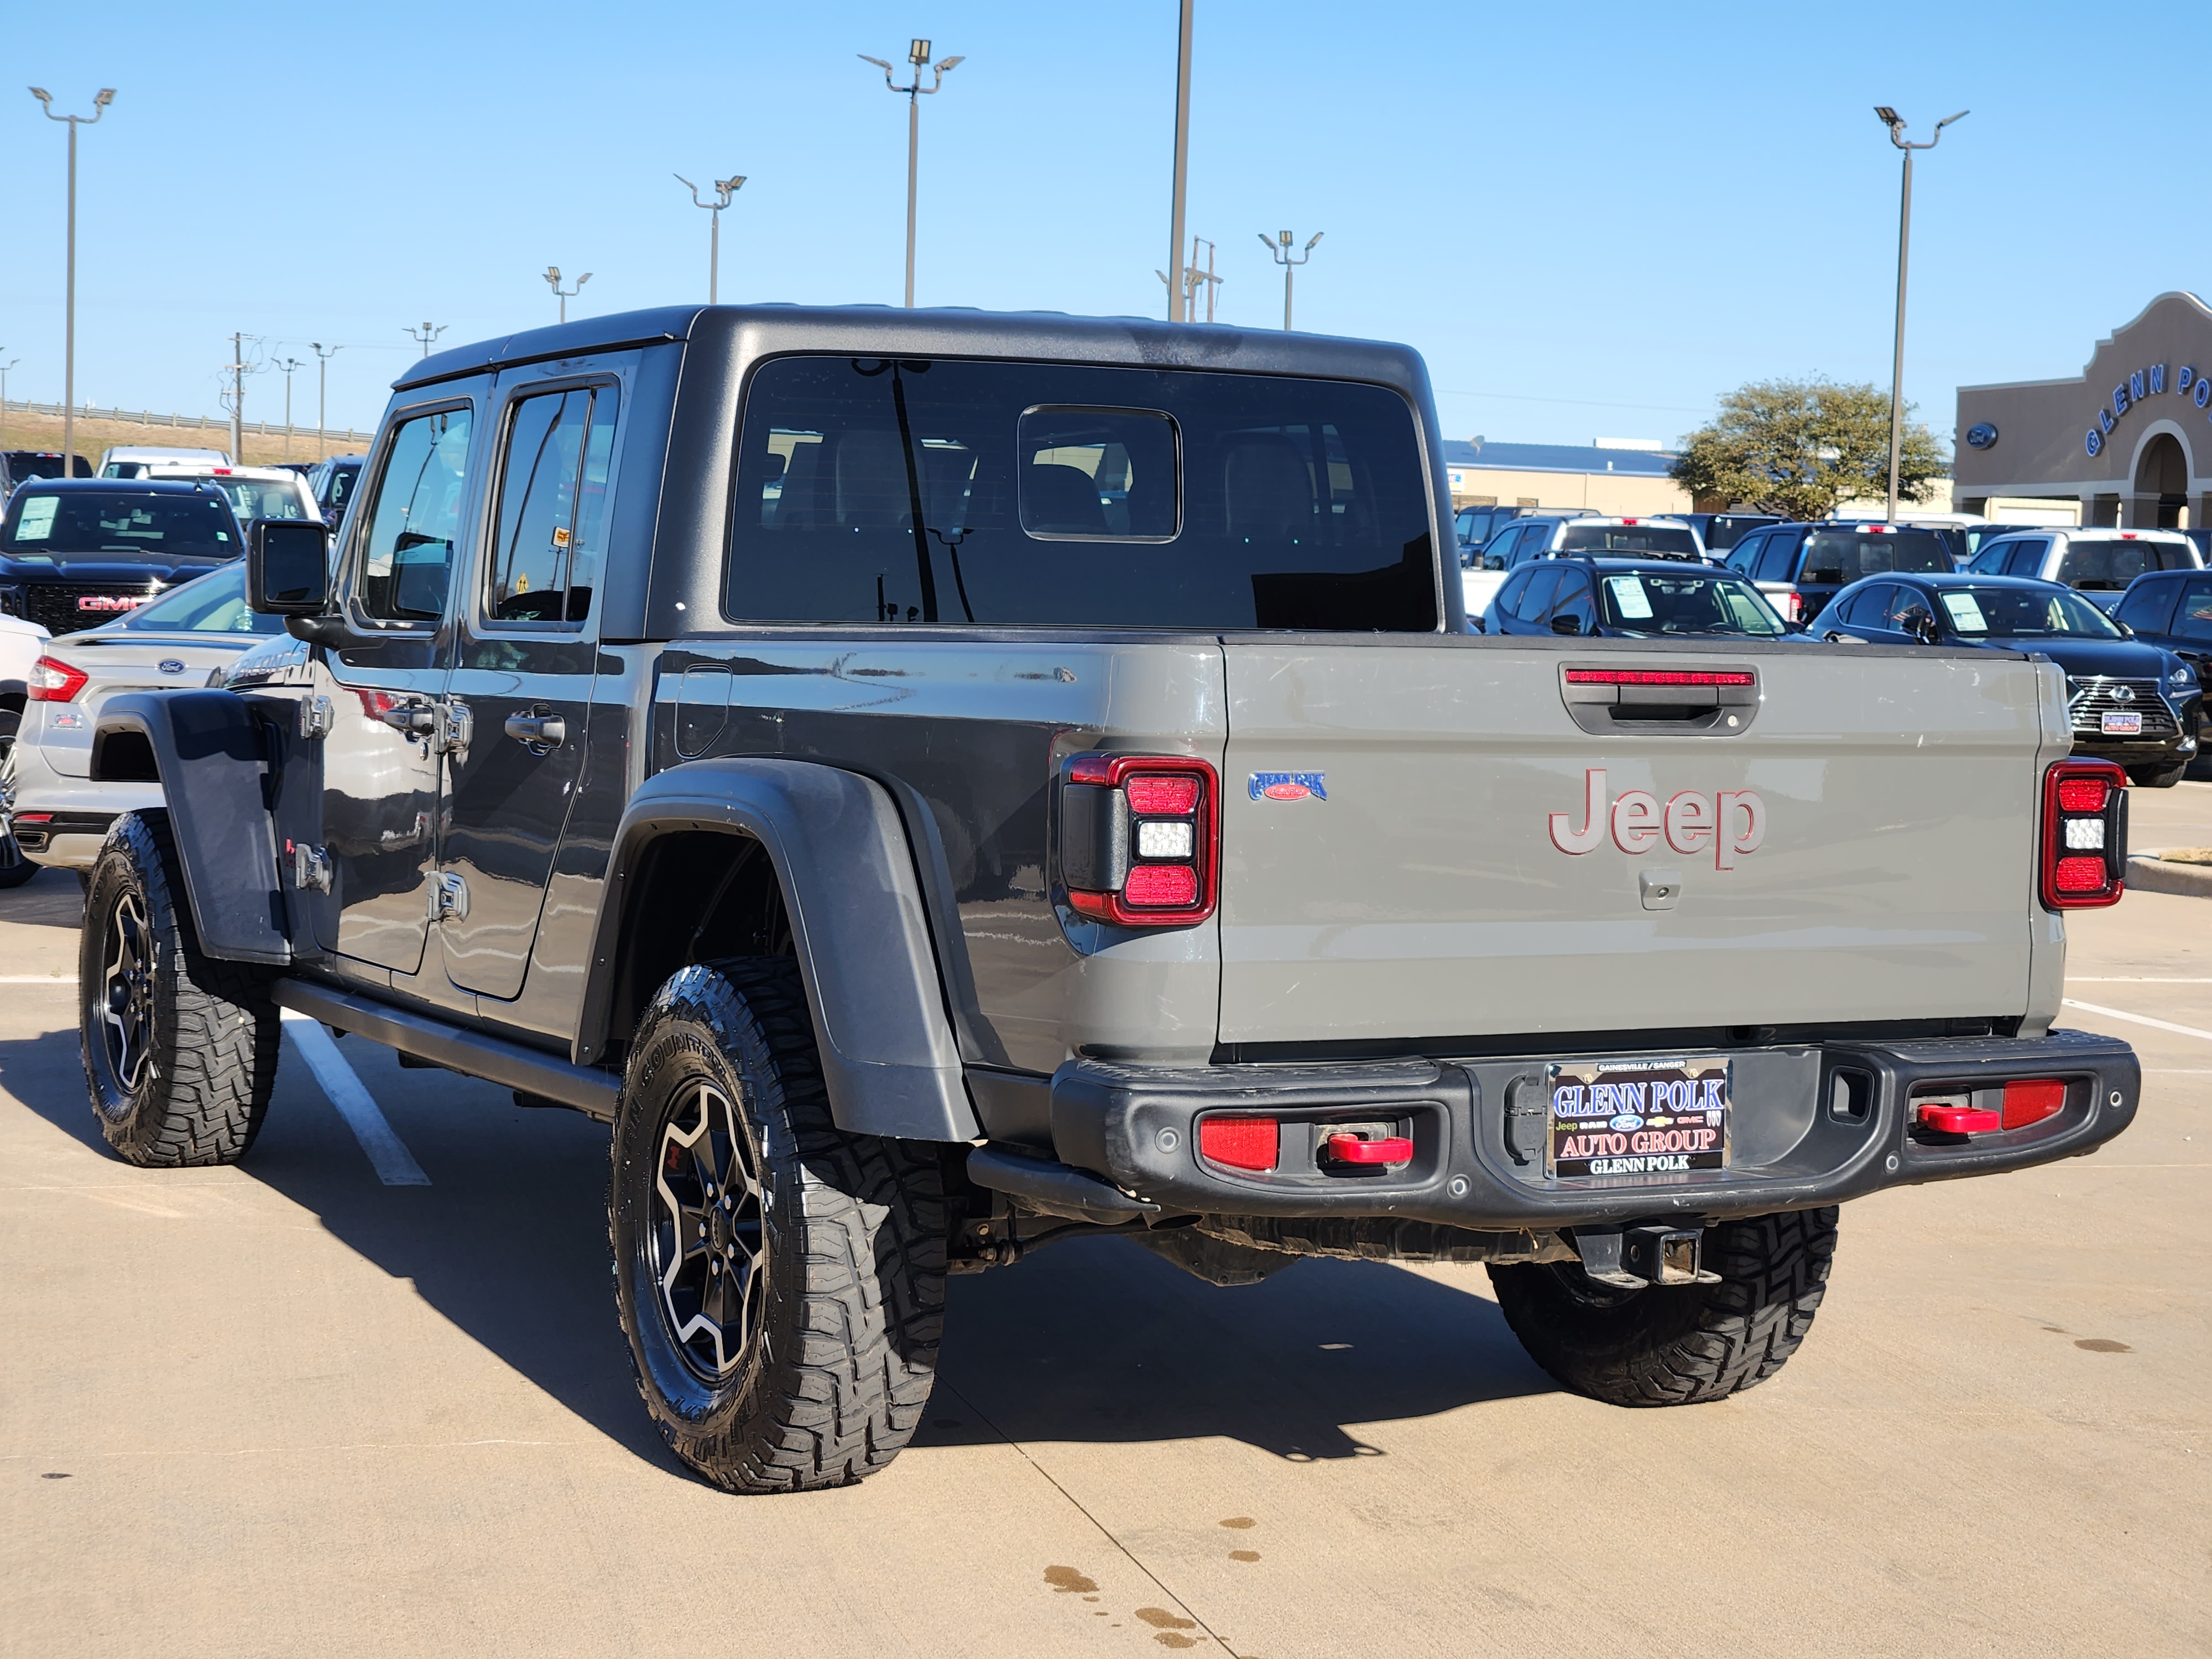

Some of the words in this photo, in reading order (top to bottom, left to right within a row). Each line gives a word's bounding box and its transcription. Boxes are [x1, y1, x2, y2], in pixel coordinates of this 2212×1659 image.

[2085, 364, 2164, 457] GLENN
[160, 660, 183, 671] Ford
[1549, 768, 1766, 871] Jeep
[1553, 1082, 1647, 1118] GLENN
[1650, 1079, 1724, 1113] POLK
[1556, 1121, 1578, 1131] Jeep
[1579, 1120, 1607, 1129] RAM
[1614, 1116, 1639, 1130] Ford
[1561, 1133, 1627, 1158] AUTO
[1631, 1129, 1717, 1154] GROUP
[1590, 1157, 1645, 1175] GLENN
[1646, 1155, 1690, 1171] POLK
